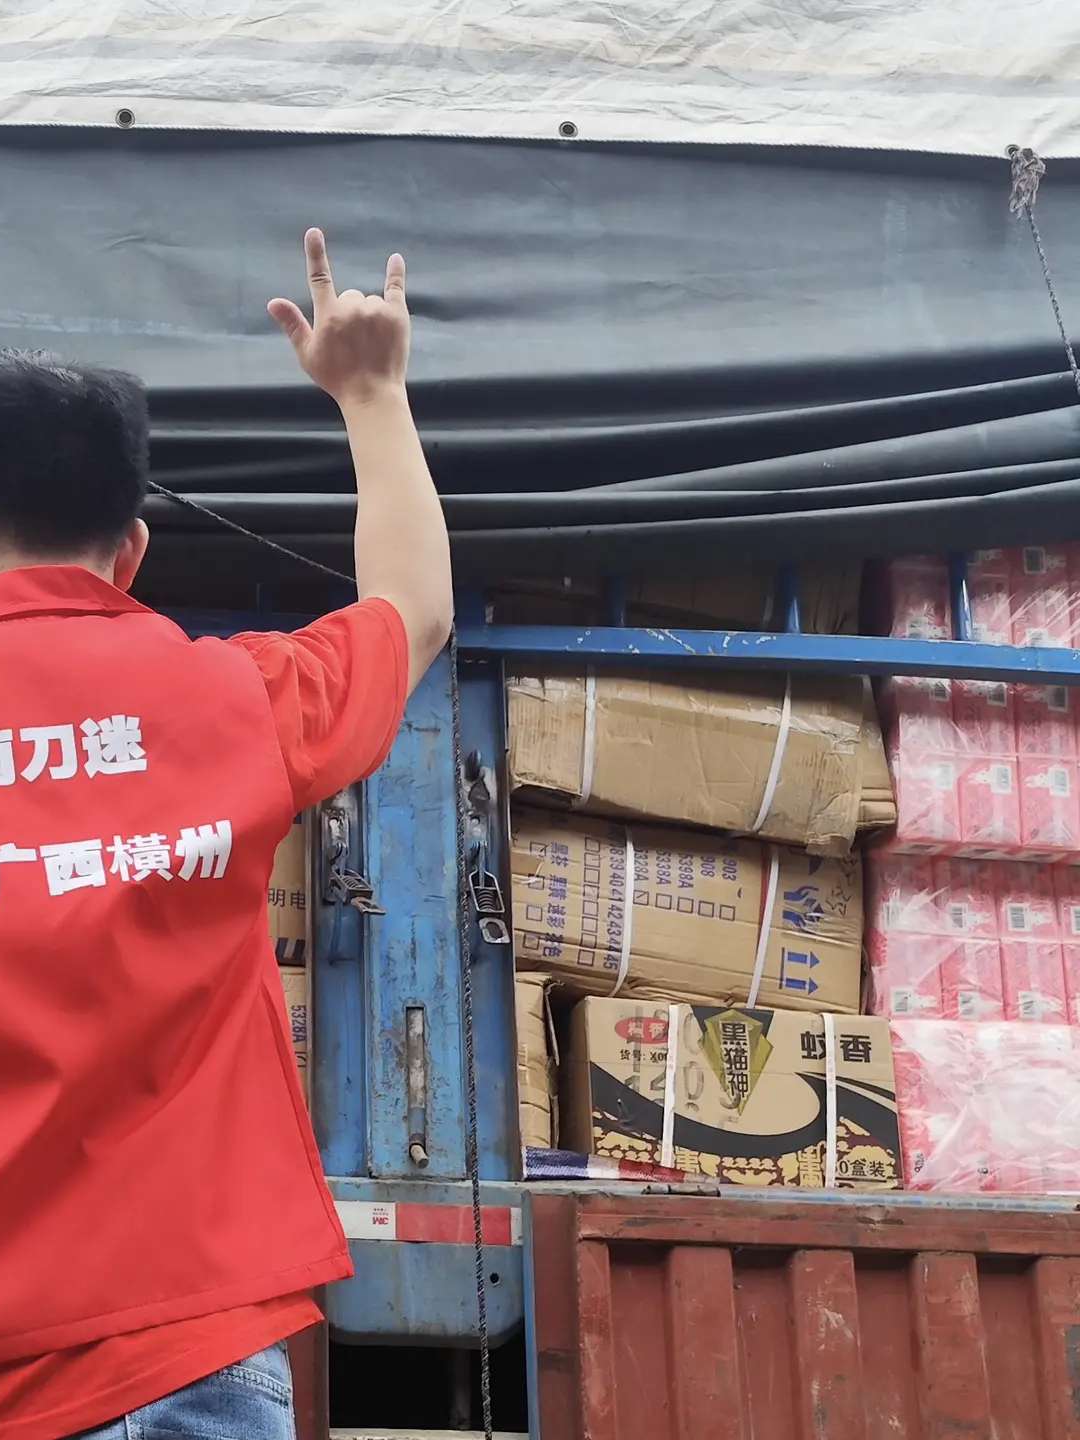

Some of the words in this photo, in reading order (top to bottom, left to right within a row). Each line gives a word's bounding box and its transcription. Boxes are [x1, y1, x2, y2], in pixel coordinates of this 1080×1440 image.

[291, 1005, 307, 1043] 5328A
[721, 1022, 750, 1098] 黑猫神
[835, 1159, 886, 1177] 0盒装
